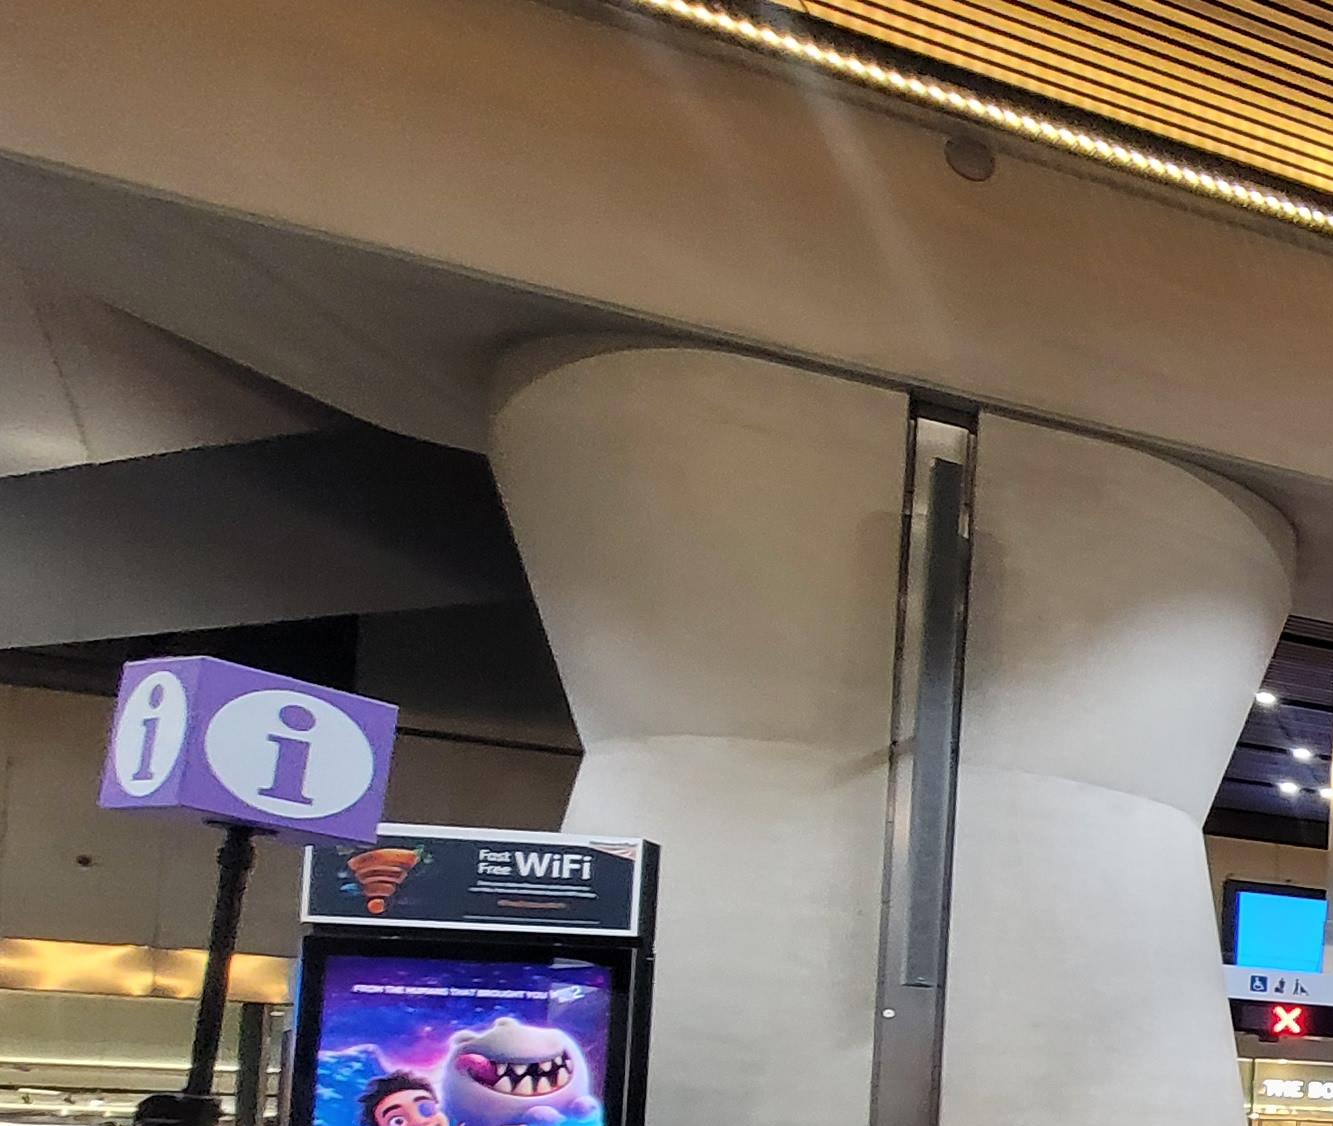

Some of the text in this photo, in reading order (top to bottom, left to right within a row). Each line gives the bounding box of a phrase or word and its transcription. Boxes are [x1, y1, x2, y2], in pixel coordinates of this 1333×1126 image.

[477, 851, 593, 880] Free WiFi
[478, 849, 512, 863] Fast
[1263, 1079, 1304, 1098] THE
